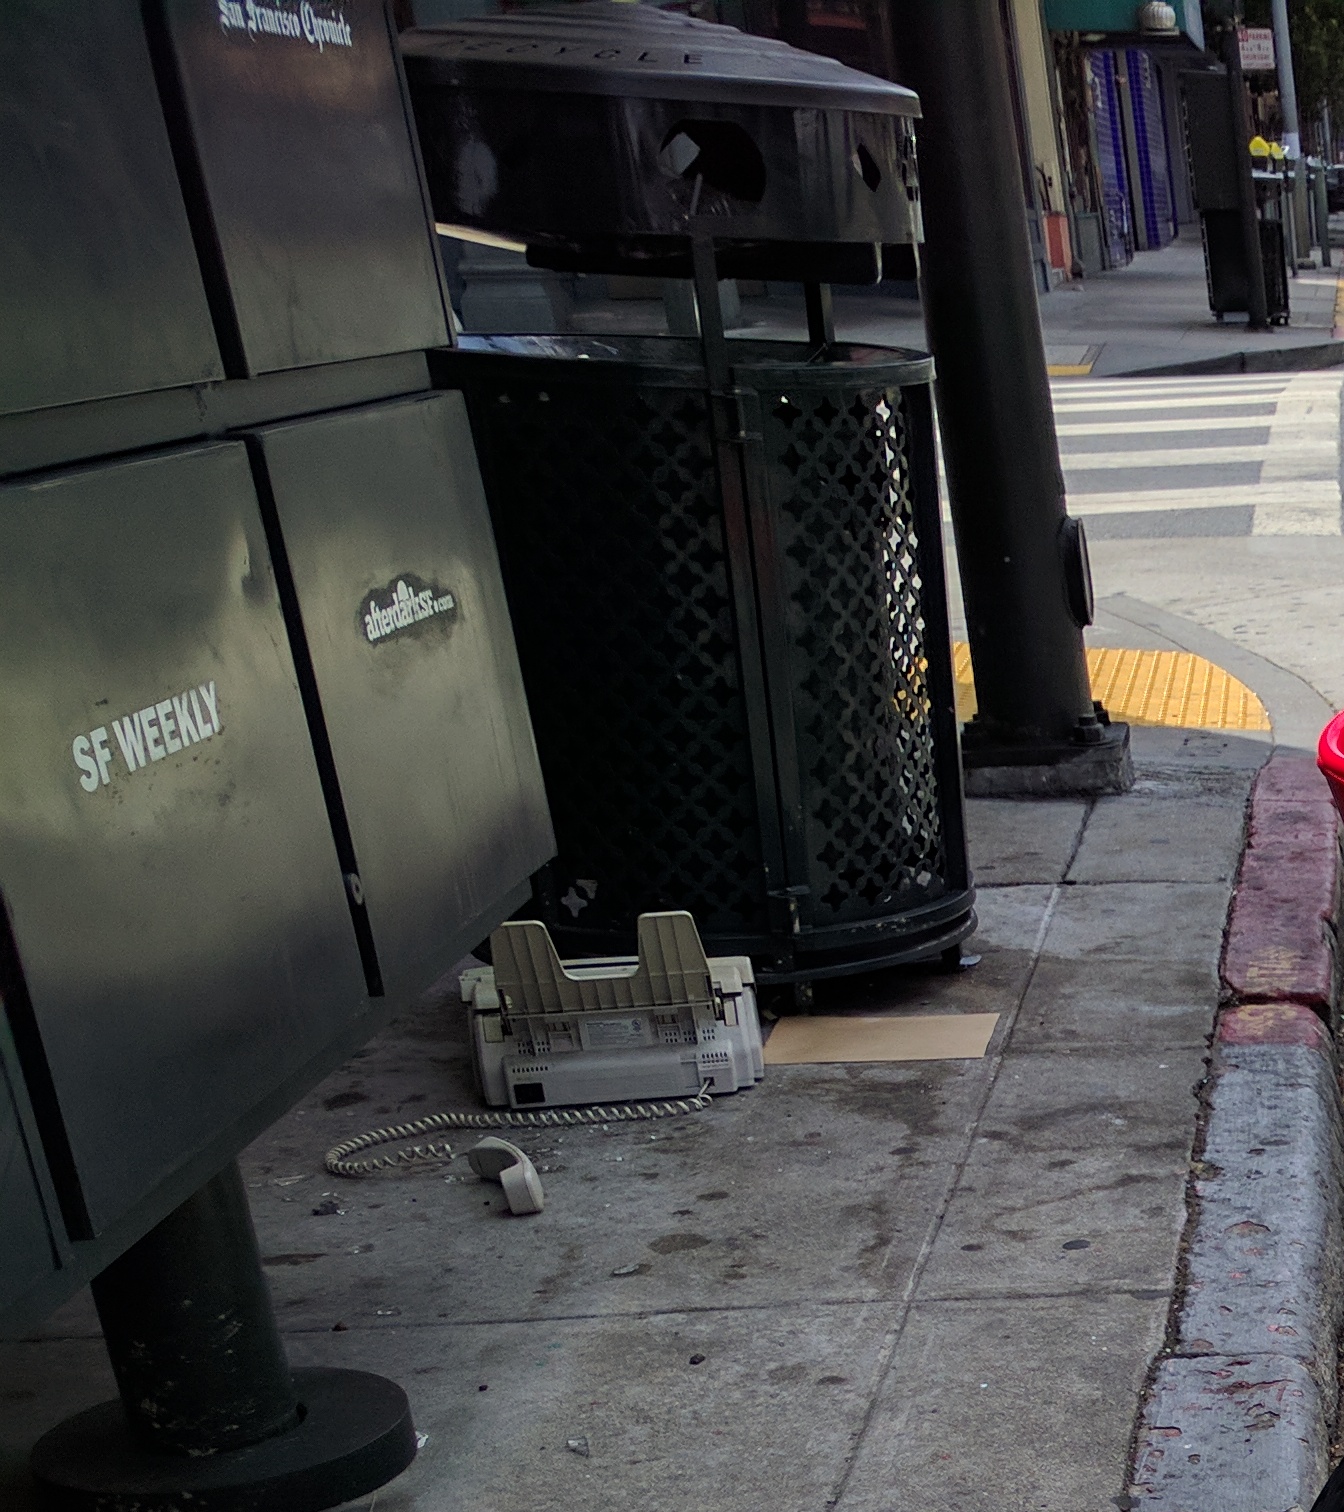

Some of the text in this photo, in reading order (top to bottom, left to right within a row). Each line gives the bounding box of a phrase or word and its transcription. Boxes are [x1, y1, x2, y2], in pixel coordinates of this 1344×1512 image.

[218, 0, 352, 53] San Francisco Chronicle
[72, 680, 222, 792] SF WEEKLY
